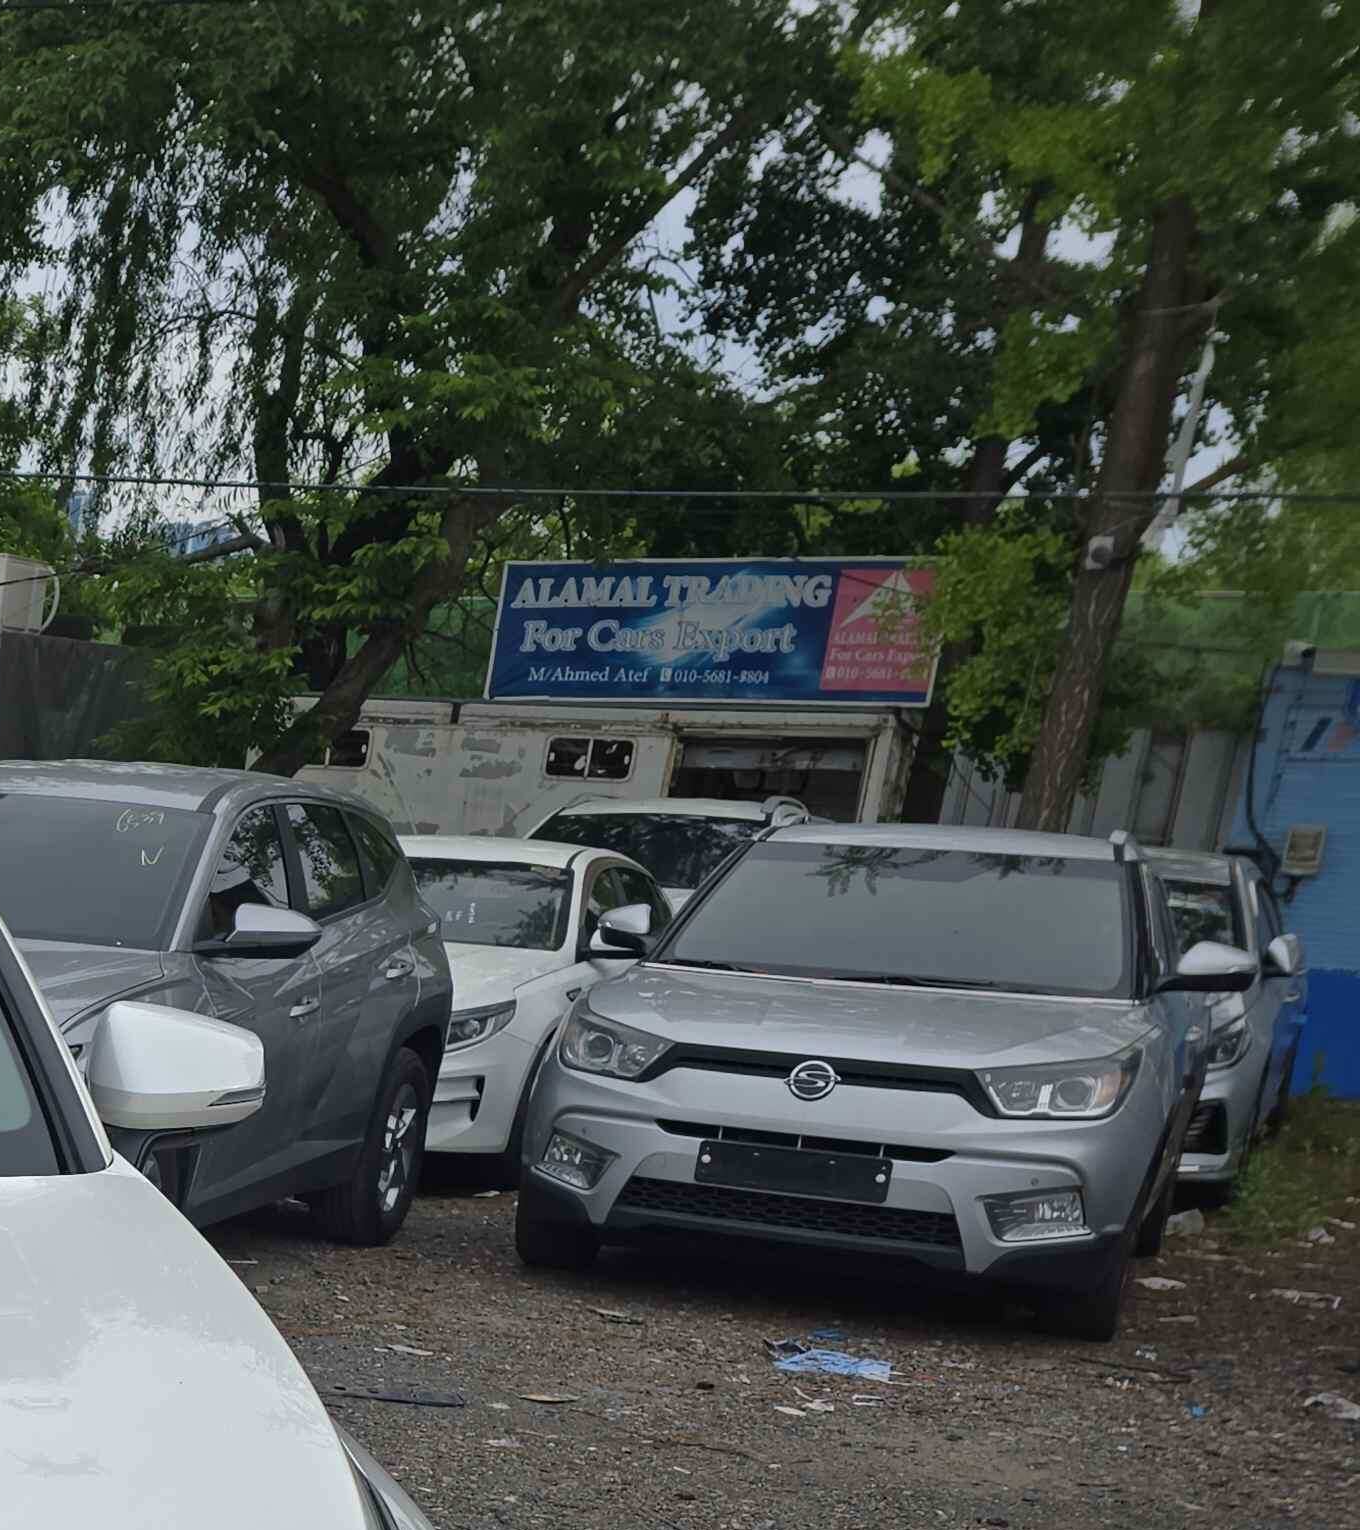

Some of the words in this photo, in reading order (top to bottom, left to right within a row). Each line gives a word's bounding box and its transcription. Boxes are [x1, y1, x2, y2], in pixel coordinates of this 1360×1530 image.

[510, 575, 658, 608] ALAMAL
[663, 573, 833, 608] TRADING
[519, 618, 584, 653] For
[586, 618, 667, 653] Cars
[671, 620, 799, 663] Export
[527, 666, 610, 682] M/Ahmed
[613, 667, 653, 682] Atef
